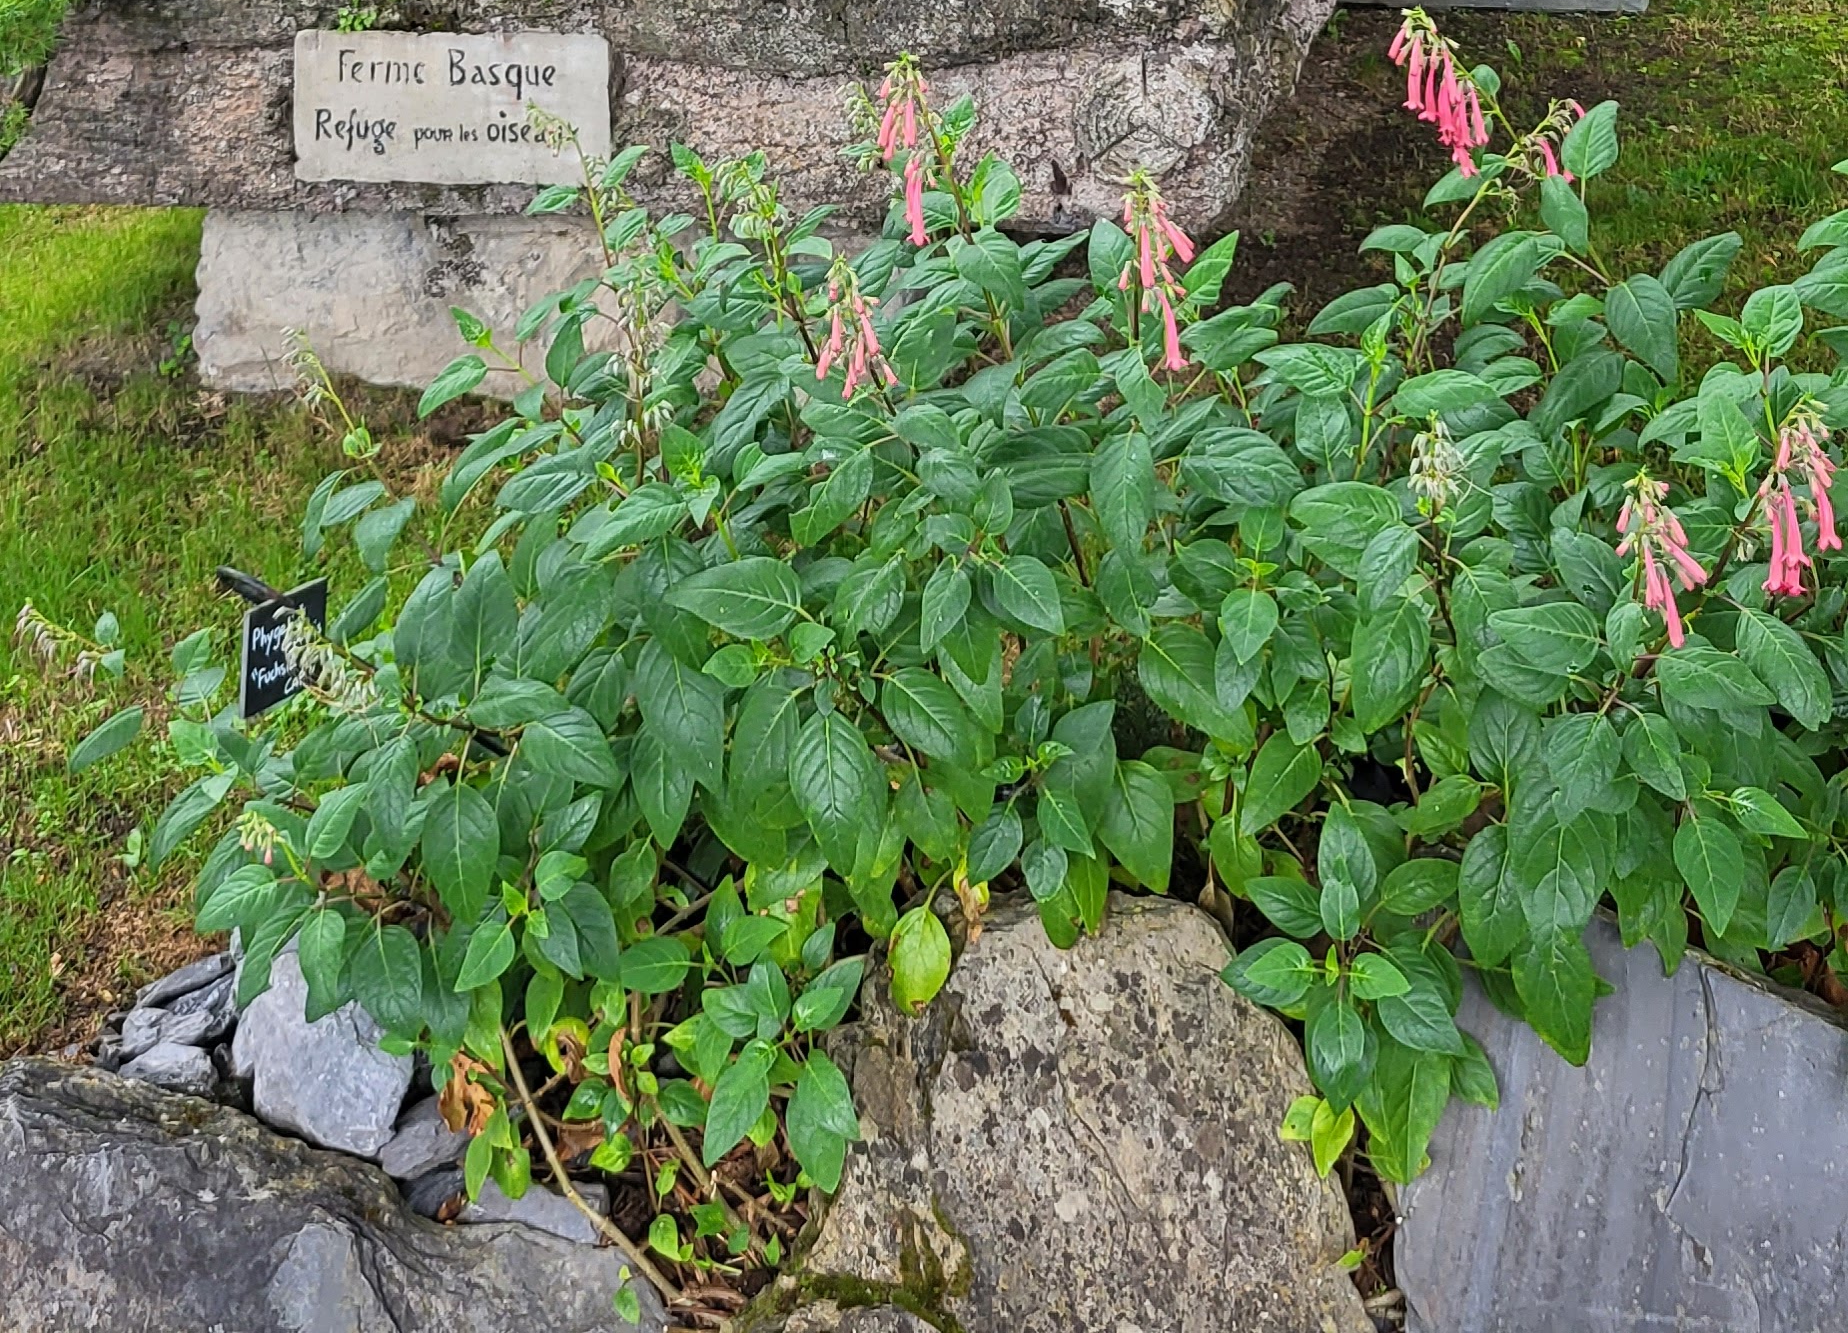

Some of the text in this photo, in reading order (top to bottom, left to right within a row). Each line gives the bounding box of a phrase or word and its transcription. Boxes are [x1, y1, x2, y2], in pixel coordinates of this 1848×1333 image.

[339, 48, 557, 100] Ferme Basque
[315, 108, 397, 155] Refuge
[459, 123, 478, 142] les
